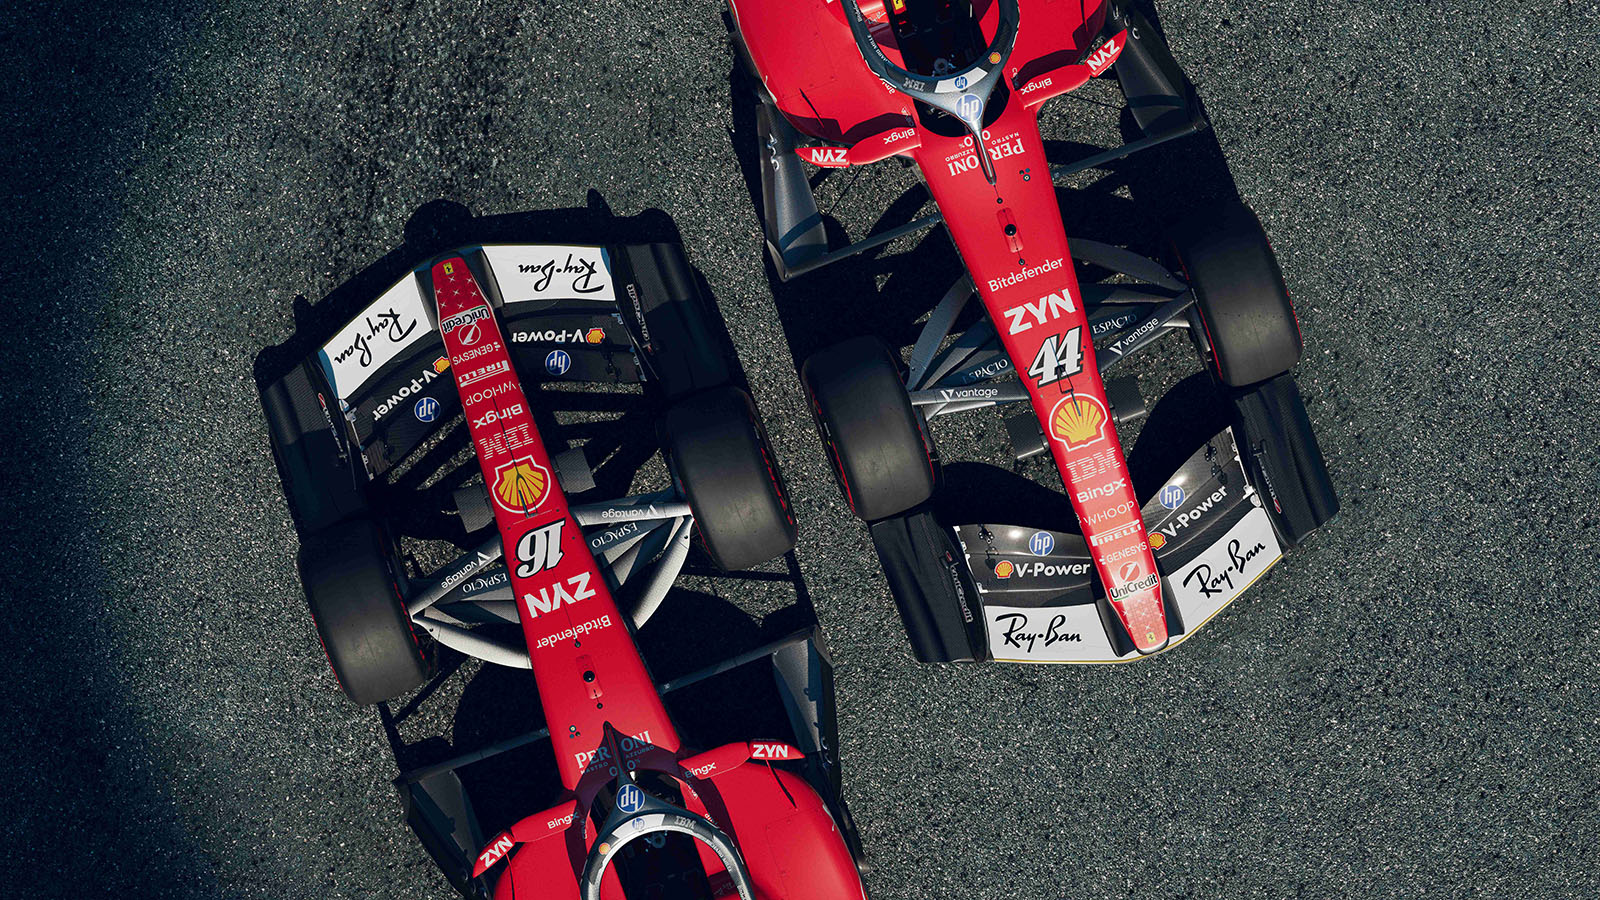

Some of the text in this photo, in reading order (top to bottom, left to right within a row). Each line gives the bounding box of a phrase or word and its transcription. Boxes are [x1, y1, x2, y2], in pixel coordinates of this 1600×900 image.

[1086, 39, 1120, 71] ZYN
[903, 77, 925, 92] IBM
[957, 95, 981, 122] hp
[811, 149, 847, 163] ZYN
[944, 131, 1020, 162] NASTRO AZZURRO
[947, 138, 1026, 177] PERONI
[988, 257, 1064, 292] Bitdefender
[442, 307, 491, 334] UniCredit
[1003, 288, 1076, 335] ZYN
[1092, 313, 1138, 335] ESPACIO
[512, 328, 586, 343] V-Power
[1122, 317, 1159, 347] vantage
[453, 345, 495, 366] GENESYS
[548, 350, 569, 375] hp
[1027, 325, 1083, 388] 44
[458, 360, 511, 387] PIRELLI
[961, 358, 1008, 385] ESPACIO
[373, 368, 438, 421] V-Power
[465, 381, 517, 406] WHOOP
[955, 386, 998, 399] vantage
[417, 397, 438, 422] hp
[479, 423, 534, 460] IBM
[1066, 447, 1120, 484] IBM
[1162, 485, 1184, 509] hp
[601, 508, 644, 519] vantage
[1083, 501, 1135, 526] WHOOP
[1161, 484, 1229, 538] V-Power
[592, 522, 638, 548] ESPACIO
[1031, 532, 1053, 556] hp
[1090, 519, 1142, 546] PIRELLI
[515, 518, 566, 578] 16
[1106, 541, 1148, 565] GENESYS
[441, 561, 477, 589] vantage
[462, 573, 508, 593] ESPACIO
[1015, 562, 1091, 577] V-Power
[523, 571, 596, 619] ZYN
[1110, 573, 1159, 600] UniCredit
[536, 614, 612, 649] Bitdefender
[574, 731, 652, 769] PERONI
[580, 745, 655, 775] NASTRO AZZURRO
[753, 744, 788, 758] ZYN
[619, 784, 641, 813] hp
[674, 816, 697, 830] IBM
[480, 836, 514, 868] ZYN
